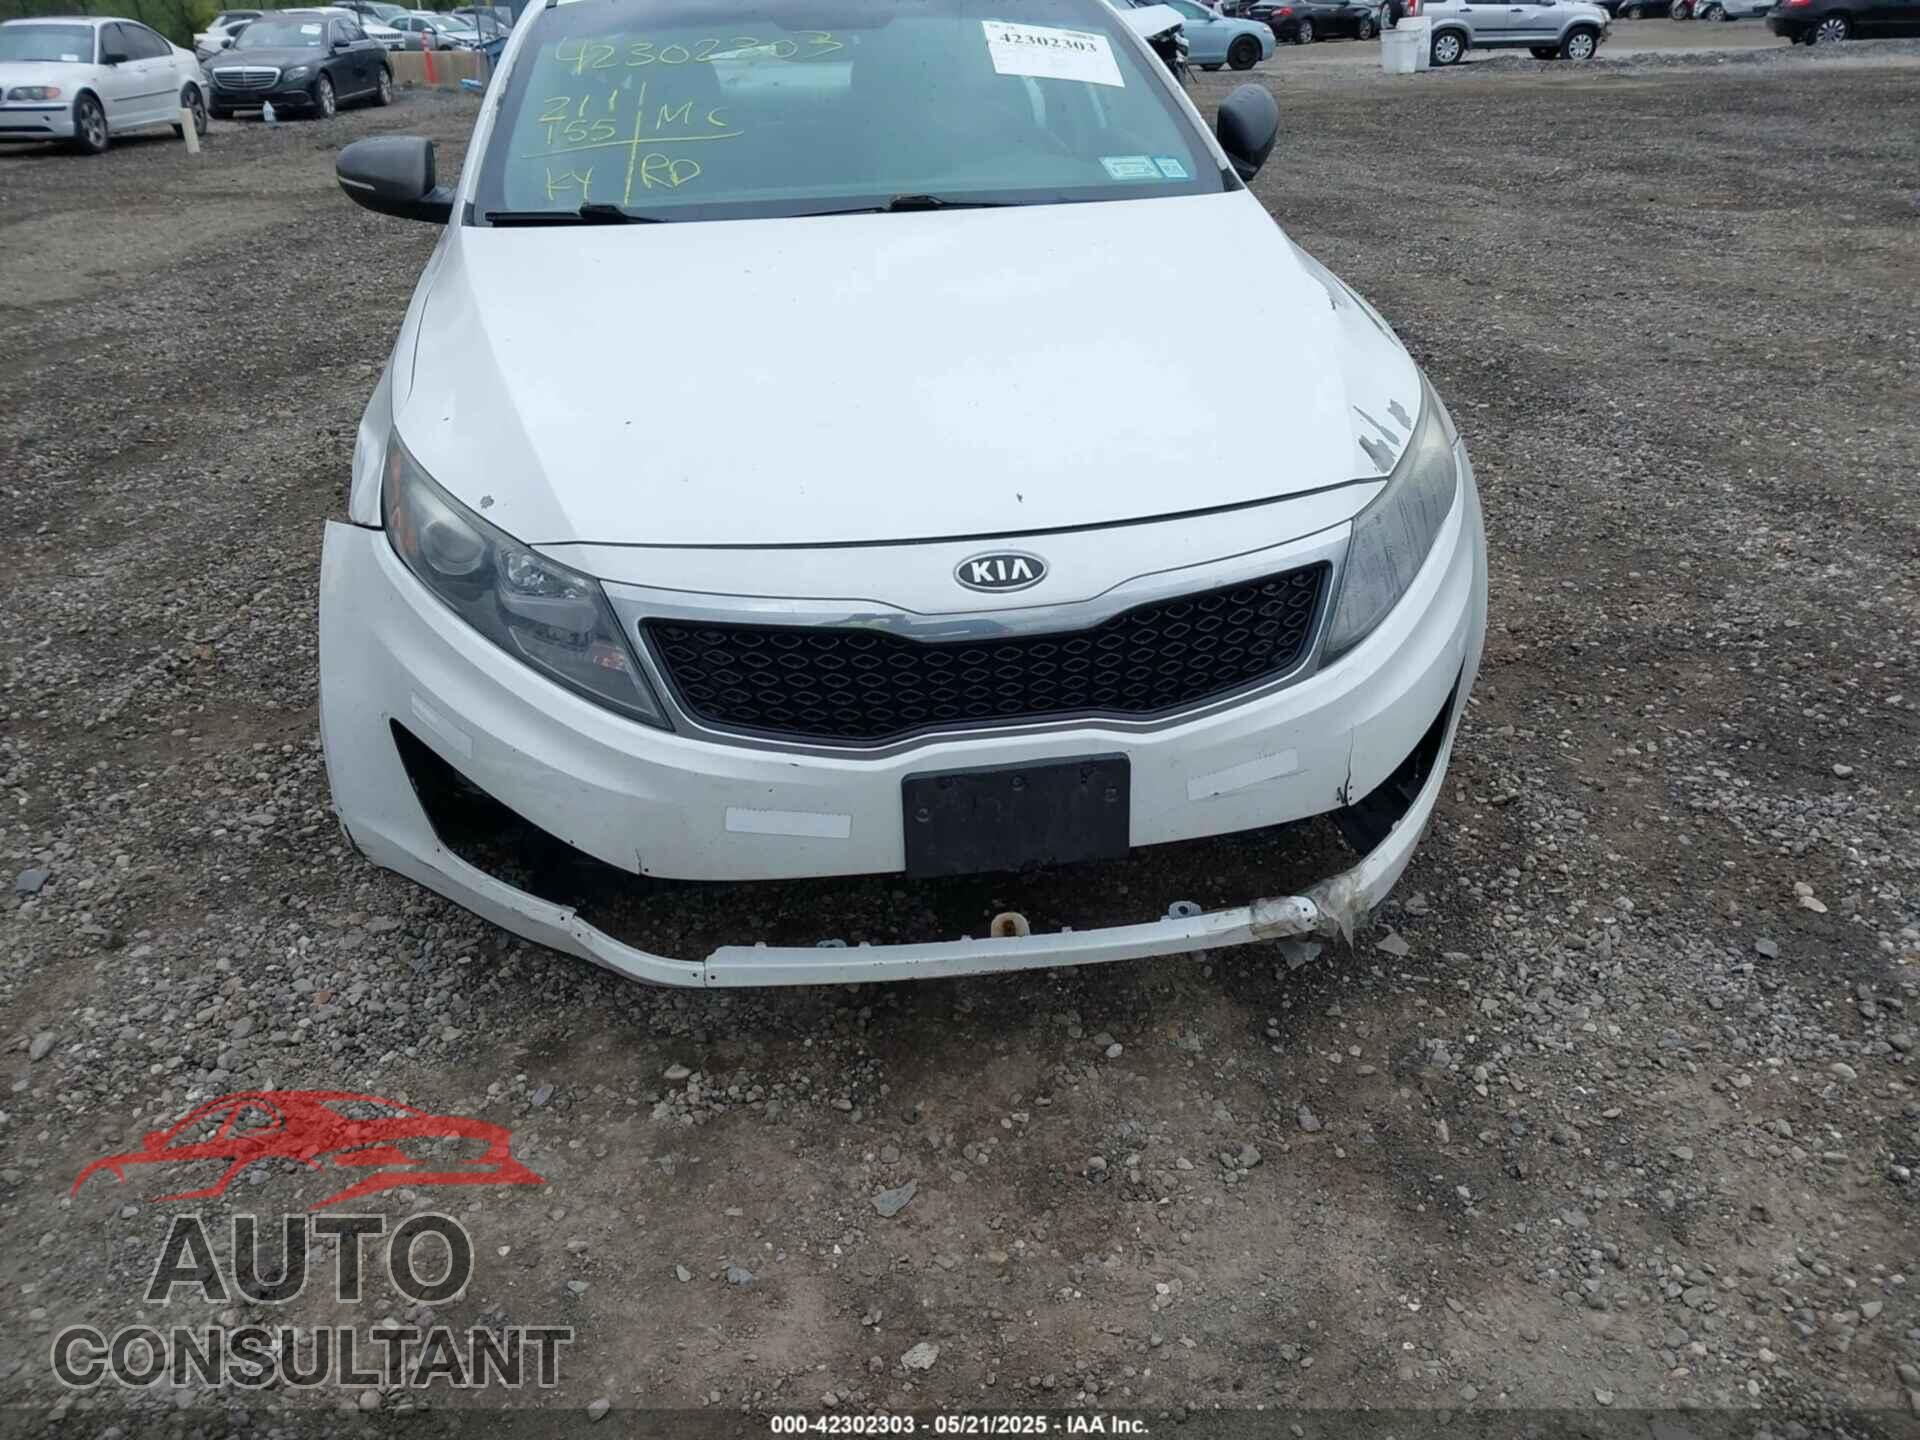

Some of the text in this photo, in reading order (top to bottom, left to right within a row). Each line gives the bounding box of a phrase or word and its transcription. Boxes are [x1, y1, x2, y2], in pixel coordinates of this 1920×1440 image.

[555, 30, 844, 76] 42302303
[1000, 32, 1098, 53] 42302303
[970, 558, 1034, 583] KIA
